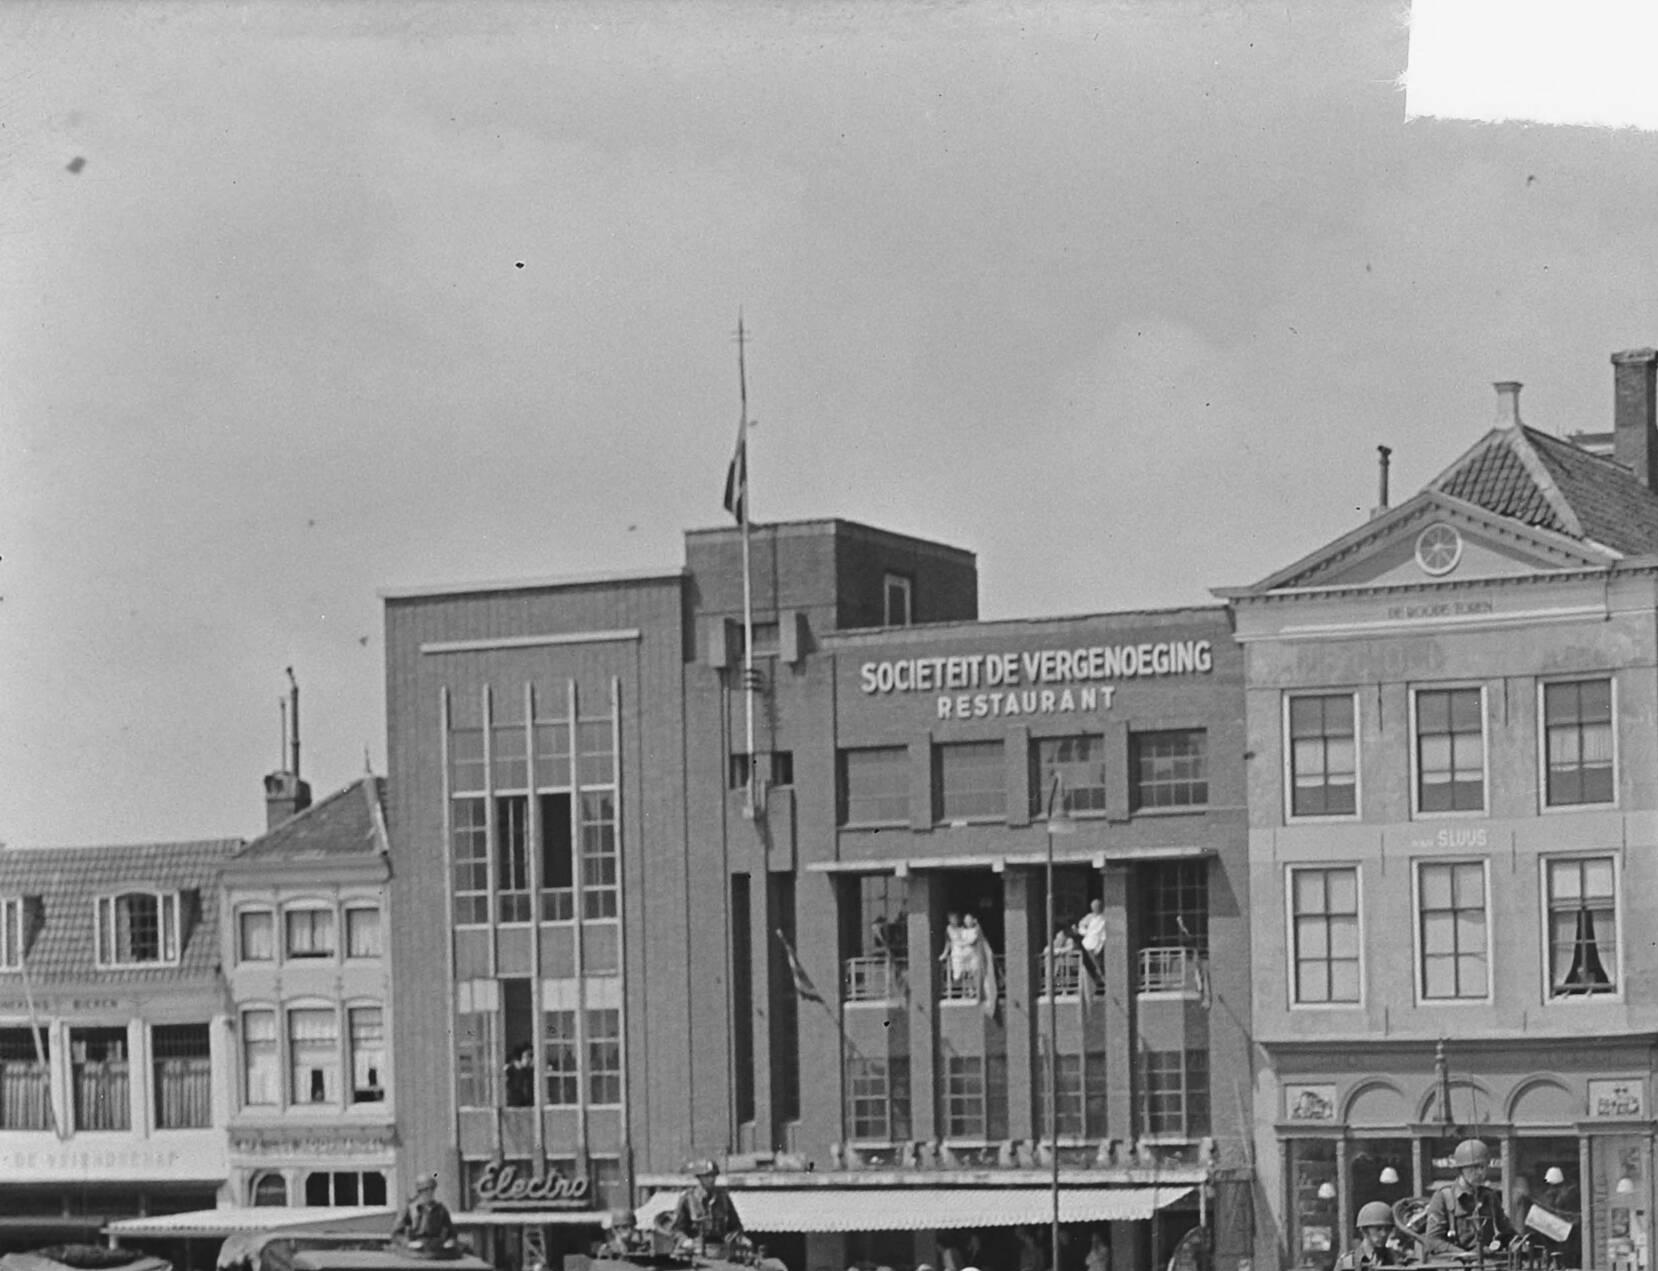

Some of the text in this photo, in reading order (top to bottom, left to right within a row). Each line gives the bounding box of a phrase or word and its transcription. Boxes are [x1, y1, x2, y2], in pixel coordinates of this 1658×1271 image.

[861, 640, 1213, 694] SOCIETEIT DE VERGENOEGING
[937, 686, 1116, 719] RESTAURANT
[476, 1161, 588, 1199] Electro
